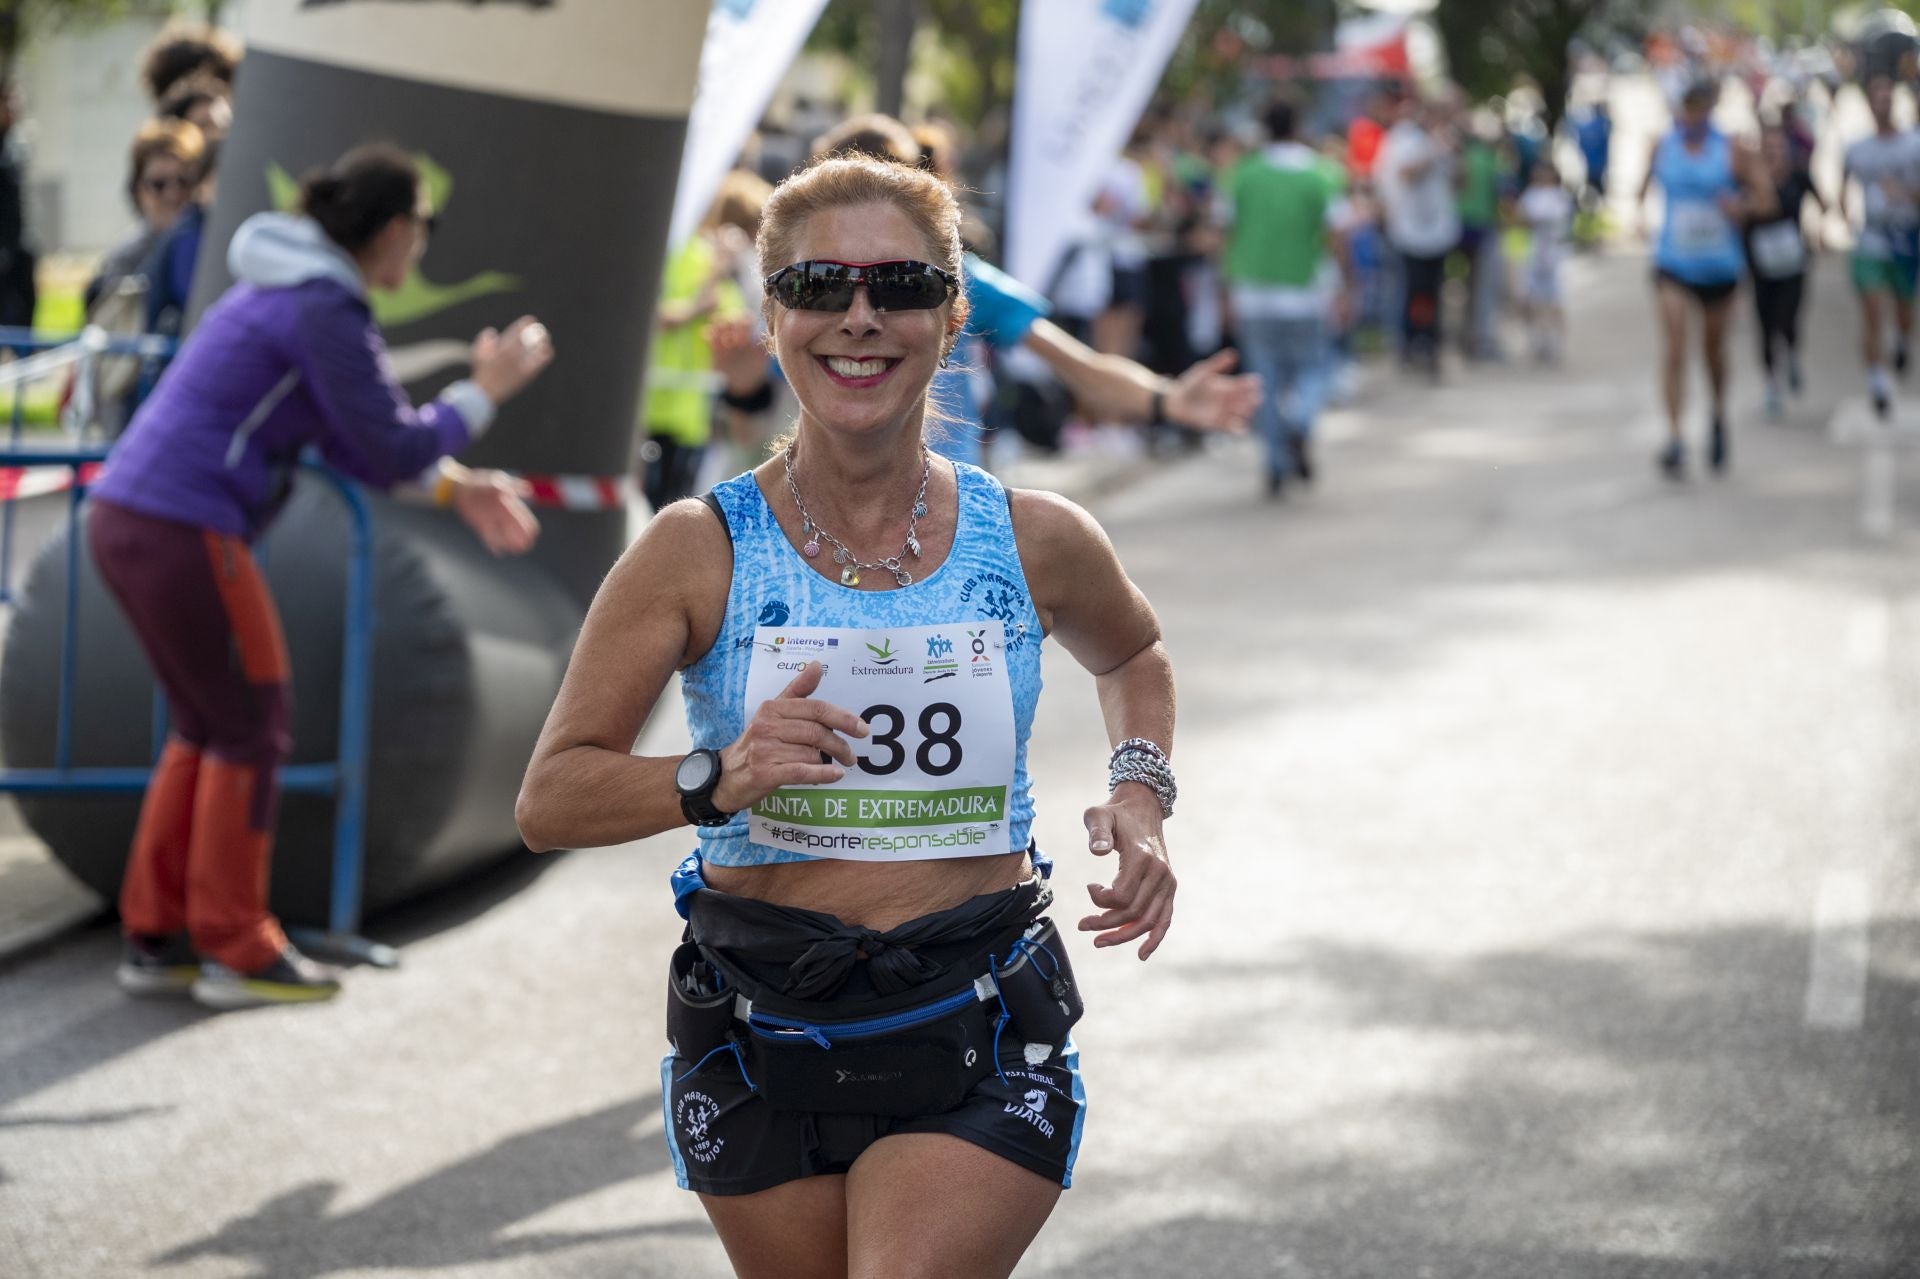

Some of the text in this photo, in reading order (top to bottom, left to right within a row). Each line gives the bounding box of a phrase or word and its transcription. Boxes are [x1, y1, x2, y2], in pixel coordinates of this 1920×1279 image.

[960, 573, 1025, 607] CLUB MARATON
[851, 665, 915, 676] Extremadura
[820, 702, 964, 777] 38
[824, 798, 848, 819] DE
[858, 795, 997, 820] EXTREMADURA
[1028, 1072, 1056, 1086] RURAL
[676, 1091, 720, 1124] CLUB MARATON
[1003, 1101, 1055, 1139] VIATOR
[694, 1140, 711, 1152] 1989
